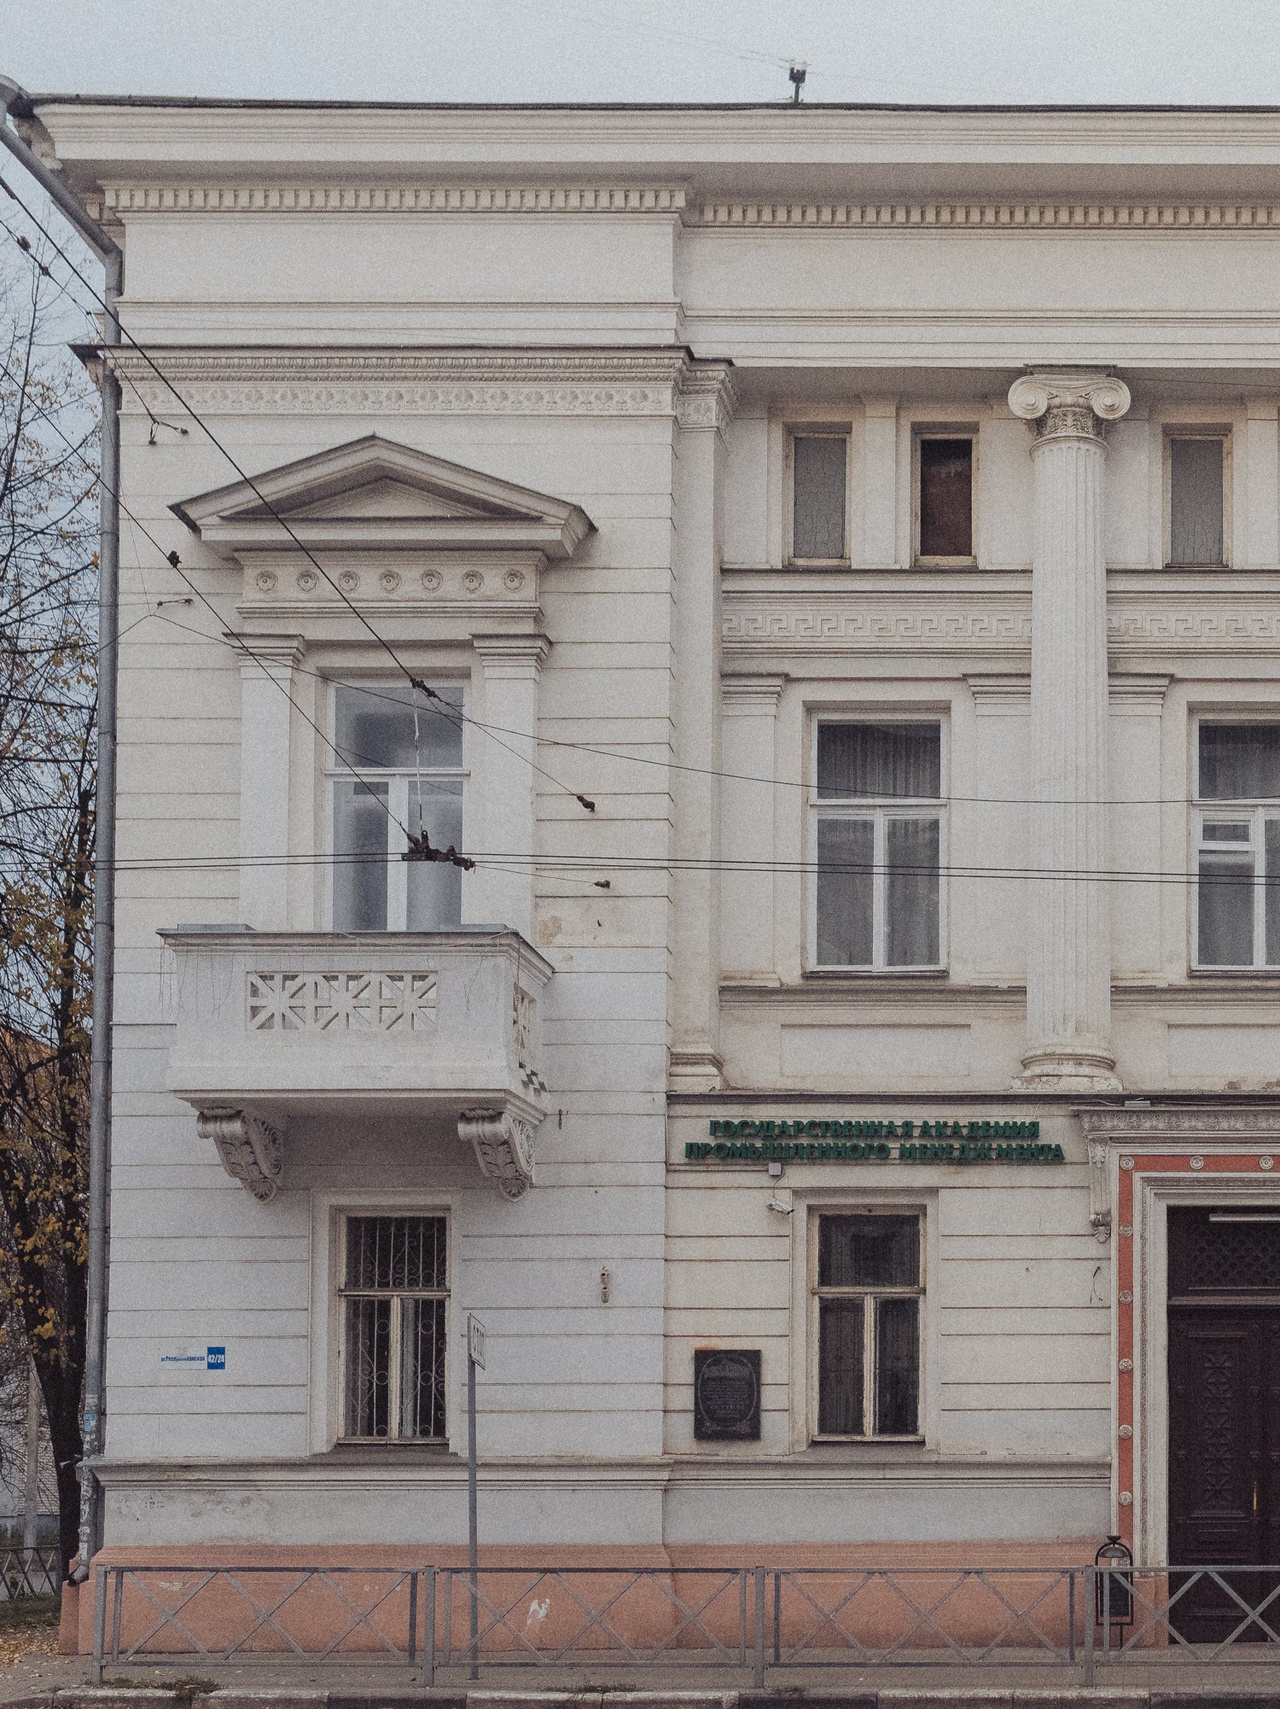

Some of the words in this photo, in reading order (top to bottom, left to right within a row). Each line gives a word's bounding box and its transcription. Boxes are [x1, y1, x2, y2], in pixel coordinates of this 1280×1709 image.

[709, 1120, 914, 1138] ГОСУДАРСТВЕННАЯ
[918, 1120, 1040, 1138] АКАДЕМИЯ
[685, 1142, 891, 1160] ПРОМЫШЛЕННОГО
[899, 1143, 1065, 1161] МЕНЕДЖМЕНТА
[208, 1354, 225, 1363] 42/24
